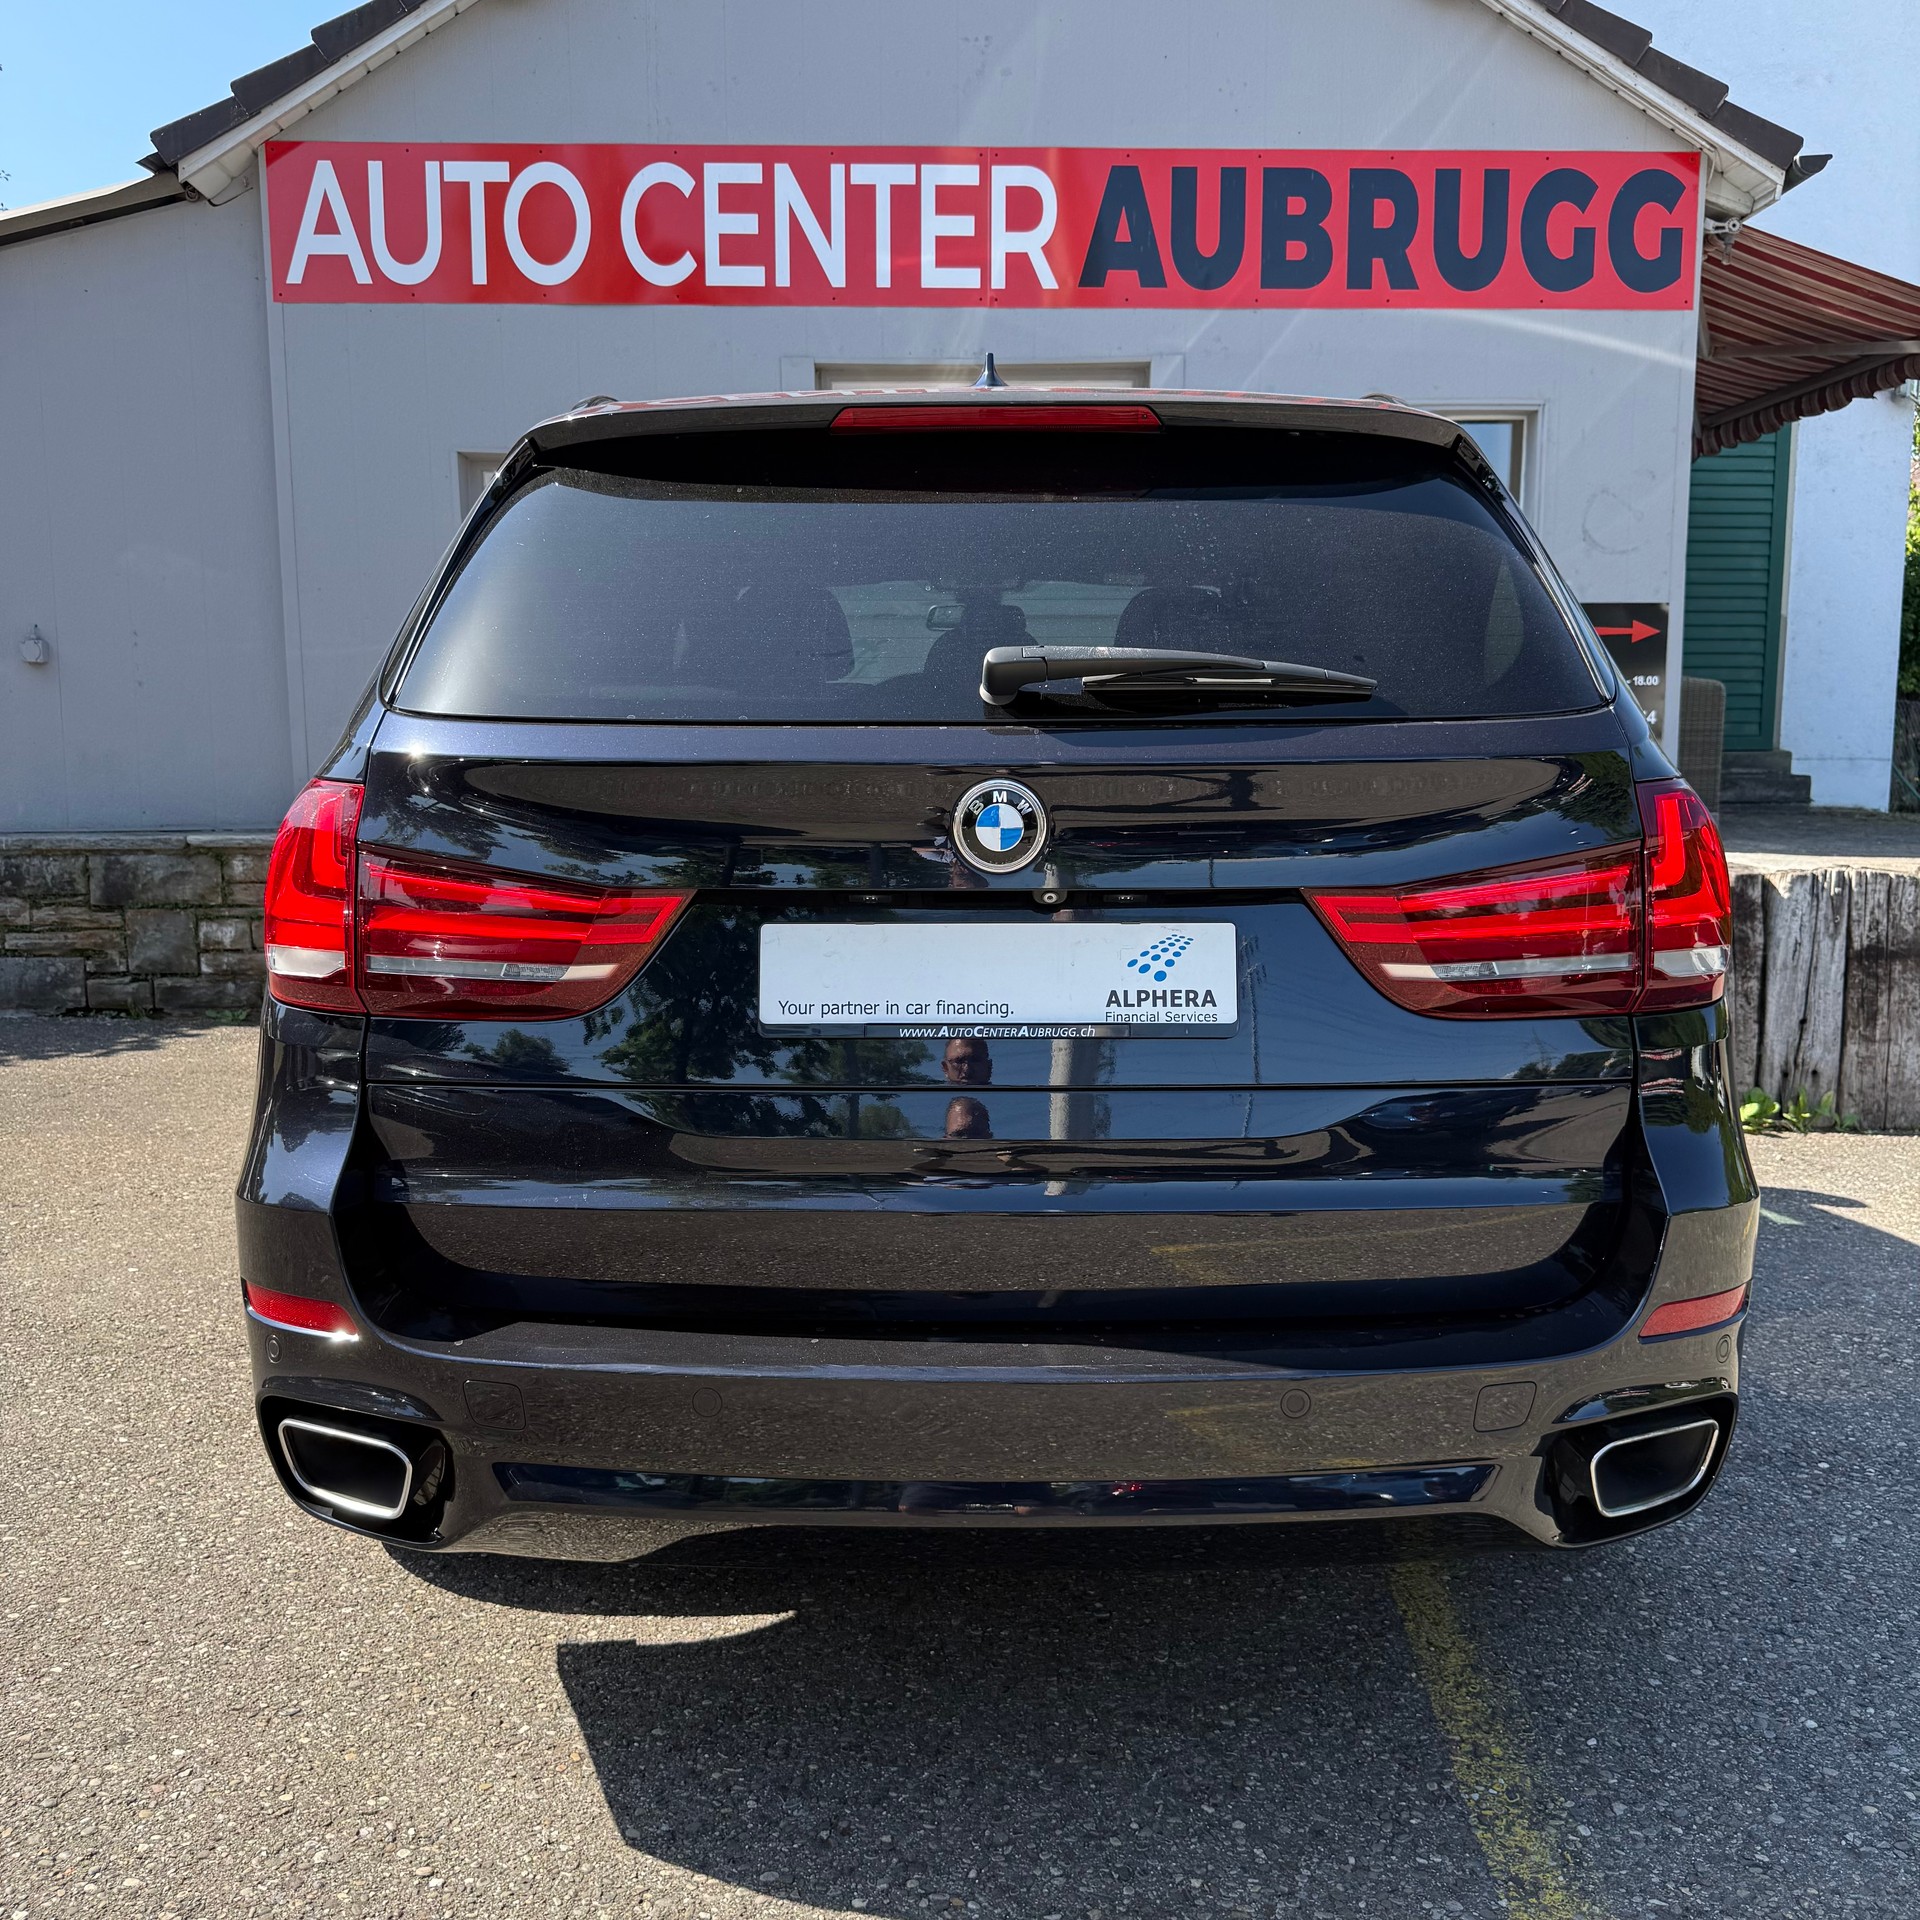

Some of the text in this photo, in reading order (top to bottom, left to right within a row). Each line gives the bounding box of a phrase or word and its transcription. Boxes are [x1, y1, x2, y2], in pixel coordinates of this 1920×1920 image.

[286, 159, 1688, 293] AUTO CENTER AUBRUGG
[1632, 675, 1659, 685] 18.00
[968, 791, 1032, 816] BMW
[1105, 989, 1217, 1008] ALPHERA
[778, 999, 1014, 1018] Your partner in car financing.
[1105, 1011, 1218, 1022] Financial Services
